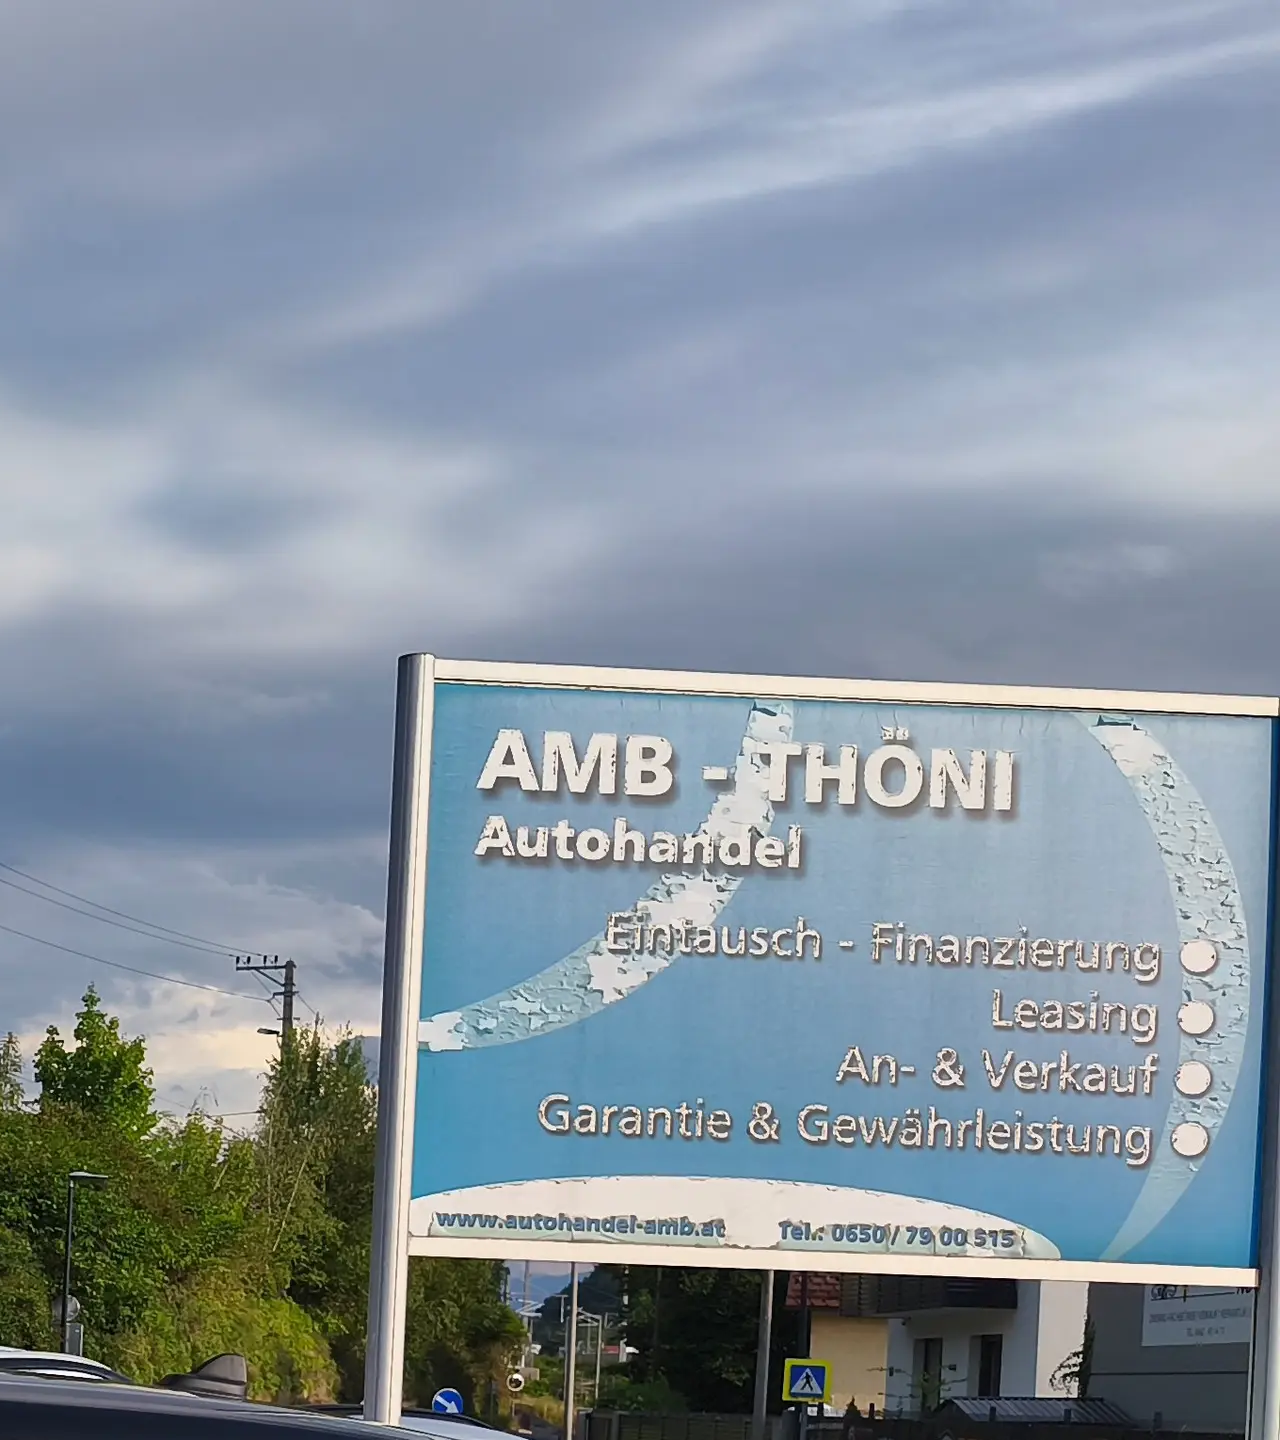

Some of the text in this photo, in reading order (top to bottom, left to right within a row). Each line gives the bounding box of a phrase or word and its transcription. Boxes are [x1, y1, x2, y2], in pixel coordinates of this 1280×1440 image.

[477, 726, 1014, 811] AMB - THÖNI
[474, 816, 802, 869] Autohandel
[606, 911, 822, 960] Eintausch
[870, 921, 1161, 981] Finanzierung
[991, 988, 1157, 1043] Leasing
[835, 1046, 1158, 1095] An- & Verkauf
[537, 1093, 1154, 1167] Garantie & Gewährleistung
[435, 1211, 727, 1239] www.autohandel-amb.at
[831, 1223, 886, 1246] 0650
[906, 1226, 934, 1248] 79
[940, 1227, 968, 1248] 00
